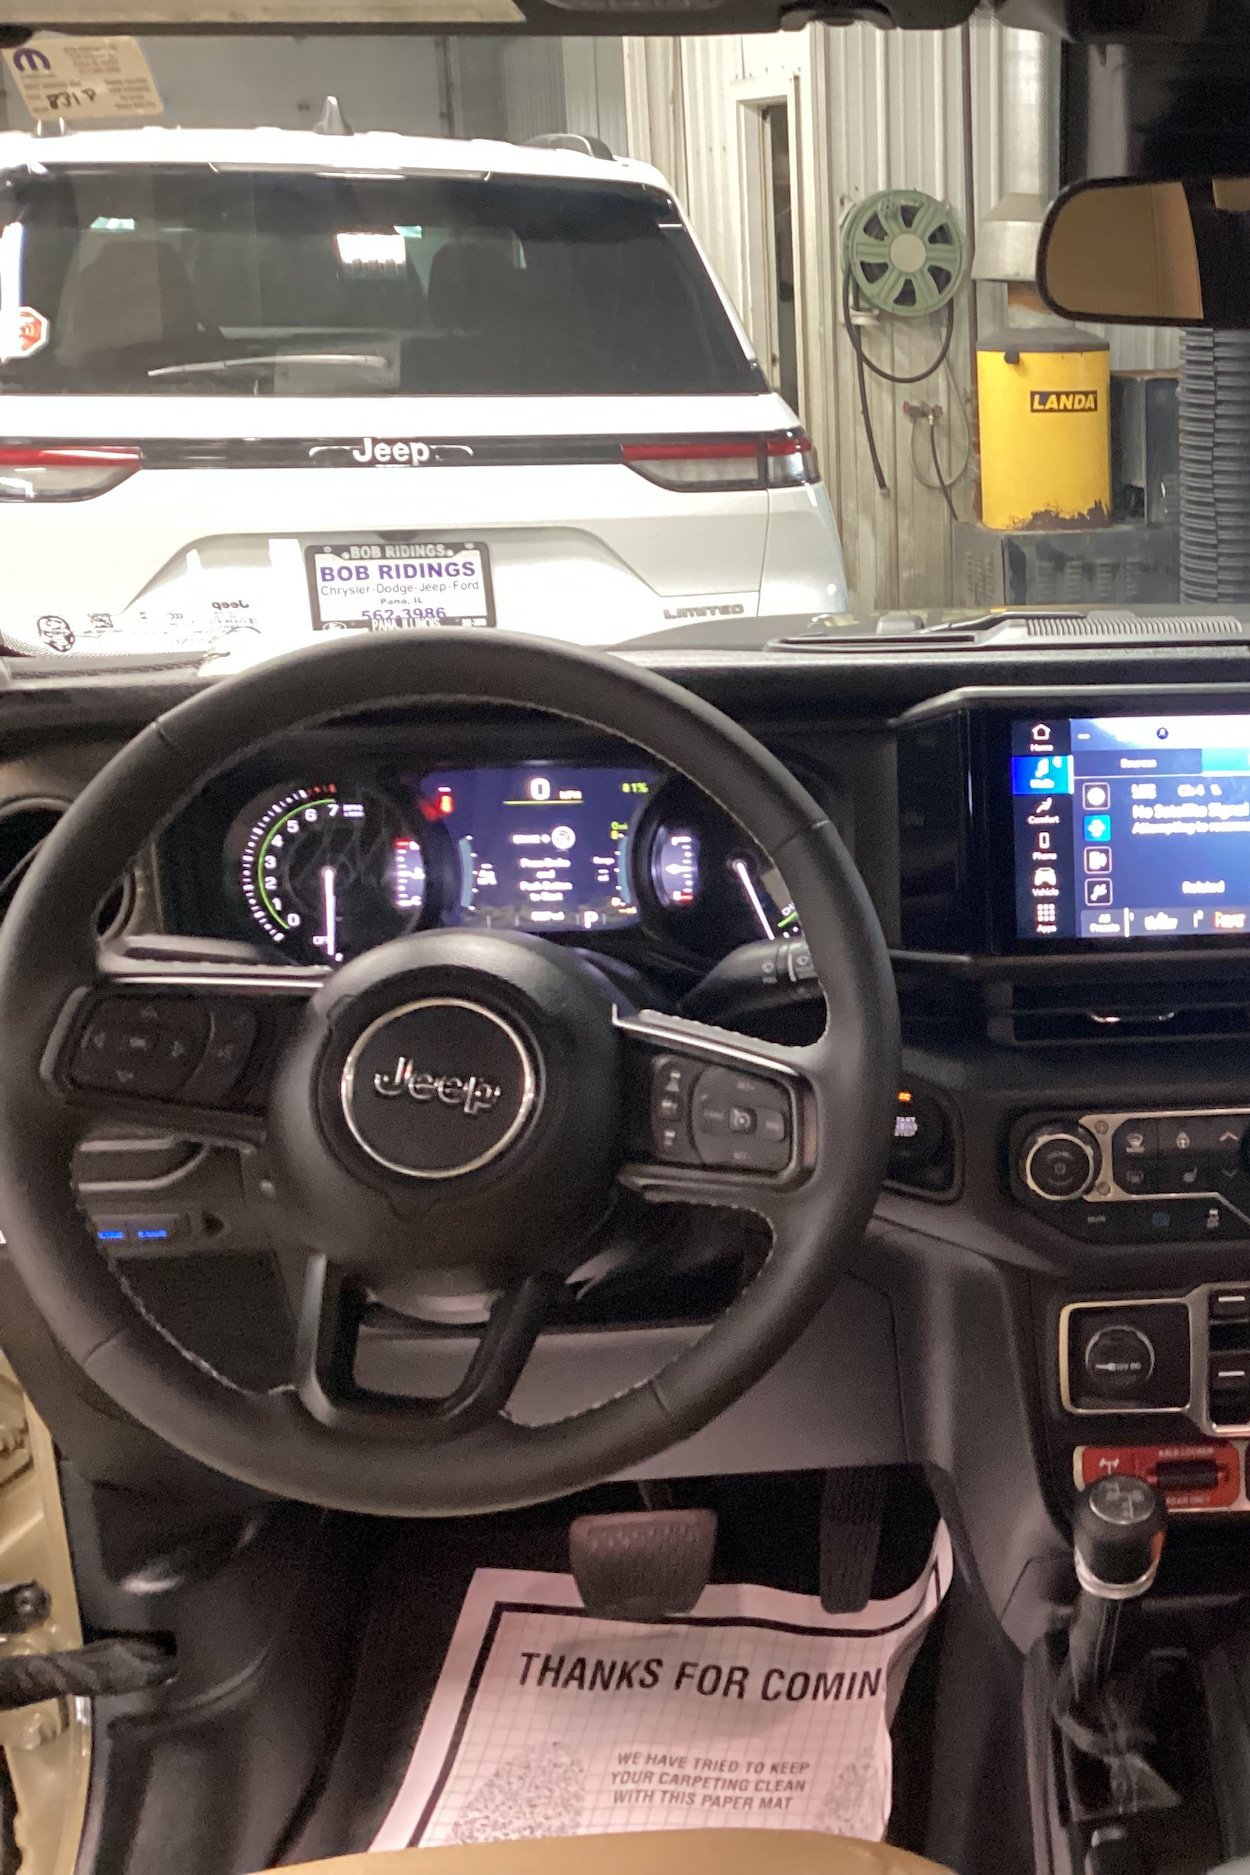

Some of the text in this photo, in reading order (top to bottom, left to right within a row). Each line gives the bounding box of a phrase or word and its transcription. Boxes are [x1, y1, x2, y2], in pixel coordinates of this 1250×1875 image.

[1032, 394, 1096, 410] LANDA
[352, 437, 430, 466] Jeep
[350, 543, 446, 559] BOB RIDINGS
[320, 561, 476, 582] BOB RIDINGS
[663, 603, 744, 620] LIMITED
[1030, 743, 1054, 752] Home
[530, 778, 550, 800] 0
[305, 808, 318, 822] 6
[1028, 815, 1060, 824] Comfort
[286, 820, 300, 834] 5
[264, 856, 277, 869] 3
[1032, 852, 1057, 860] Phone
[265, 876, 278, 890] 2
[1032, 888, 1059, 897] Vehicle
[287, 913, 301, 927] 0
[584, 911, 599, 928] P
[1037, 924, 1057, 933] Apps
[374, 1056, 502, 1115] Jeep
[519, 1652, 664, 1692] THANKS
[673, 1661, 750, 1699] FOR
[617, 1751, 811, 1775] WE HAVE TRIED TO KEEP
[610, 1771, 807, 1793] YOUR CARPETING CLEAN
[613, 1788, 795, 1811] WITH THIS PAPER MAT
